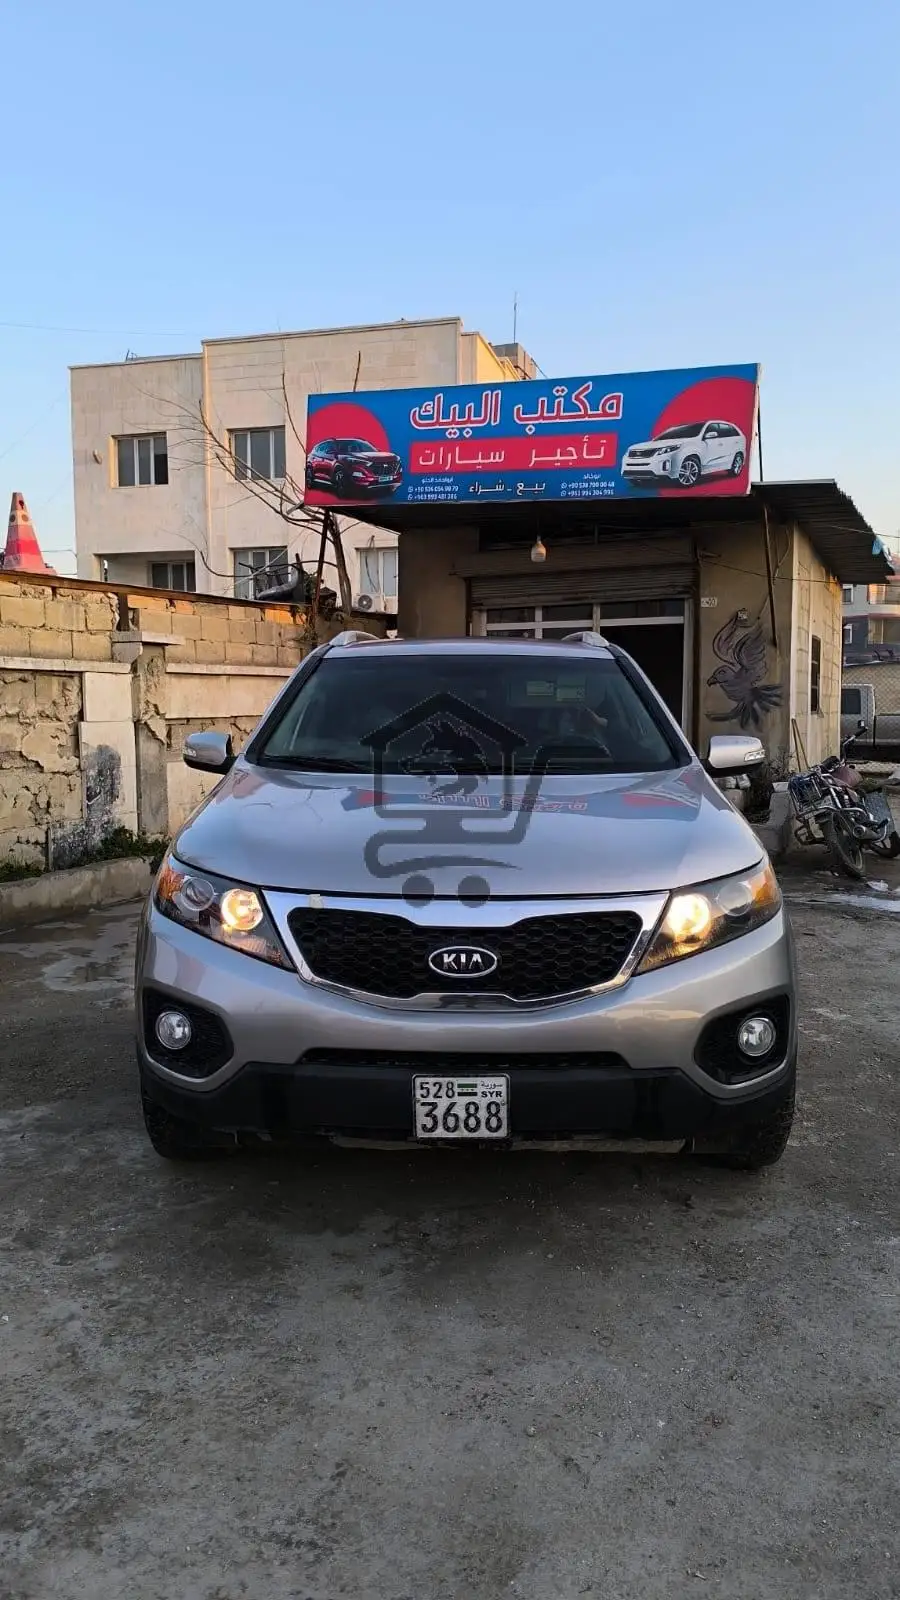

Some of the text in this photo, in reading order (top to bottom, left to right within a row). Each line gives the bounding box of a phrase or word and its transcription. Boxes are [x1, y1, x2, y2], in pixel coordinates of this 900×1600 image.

[409, 381, 623, 438] مكتب البيك
[418, 444, 504, 470] سيارات
[469, 479, 505, 495] شراء
[516, 481, 546, 496] بيع
[442, 953, 485, 970] KIA
[420, 1081, 455, 1099] 528
[480, 1090, 503, 1098] SYR
[420, 1101, 503, 1133] 3688
